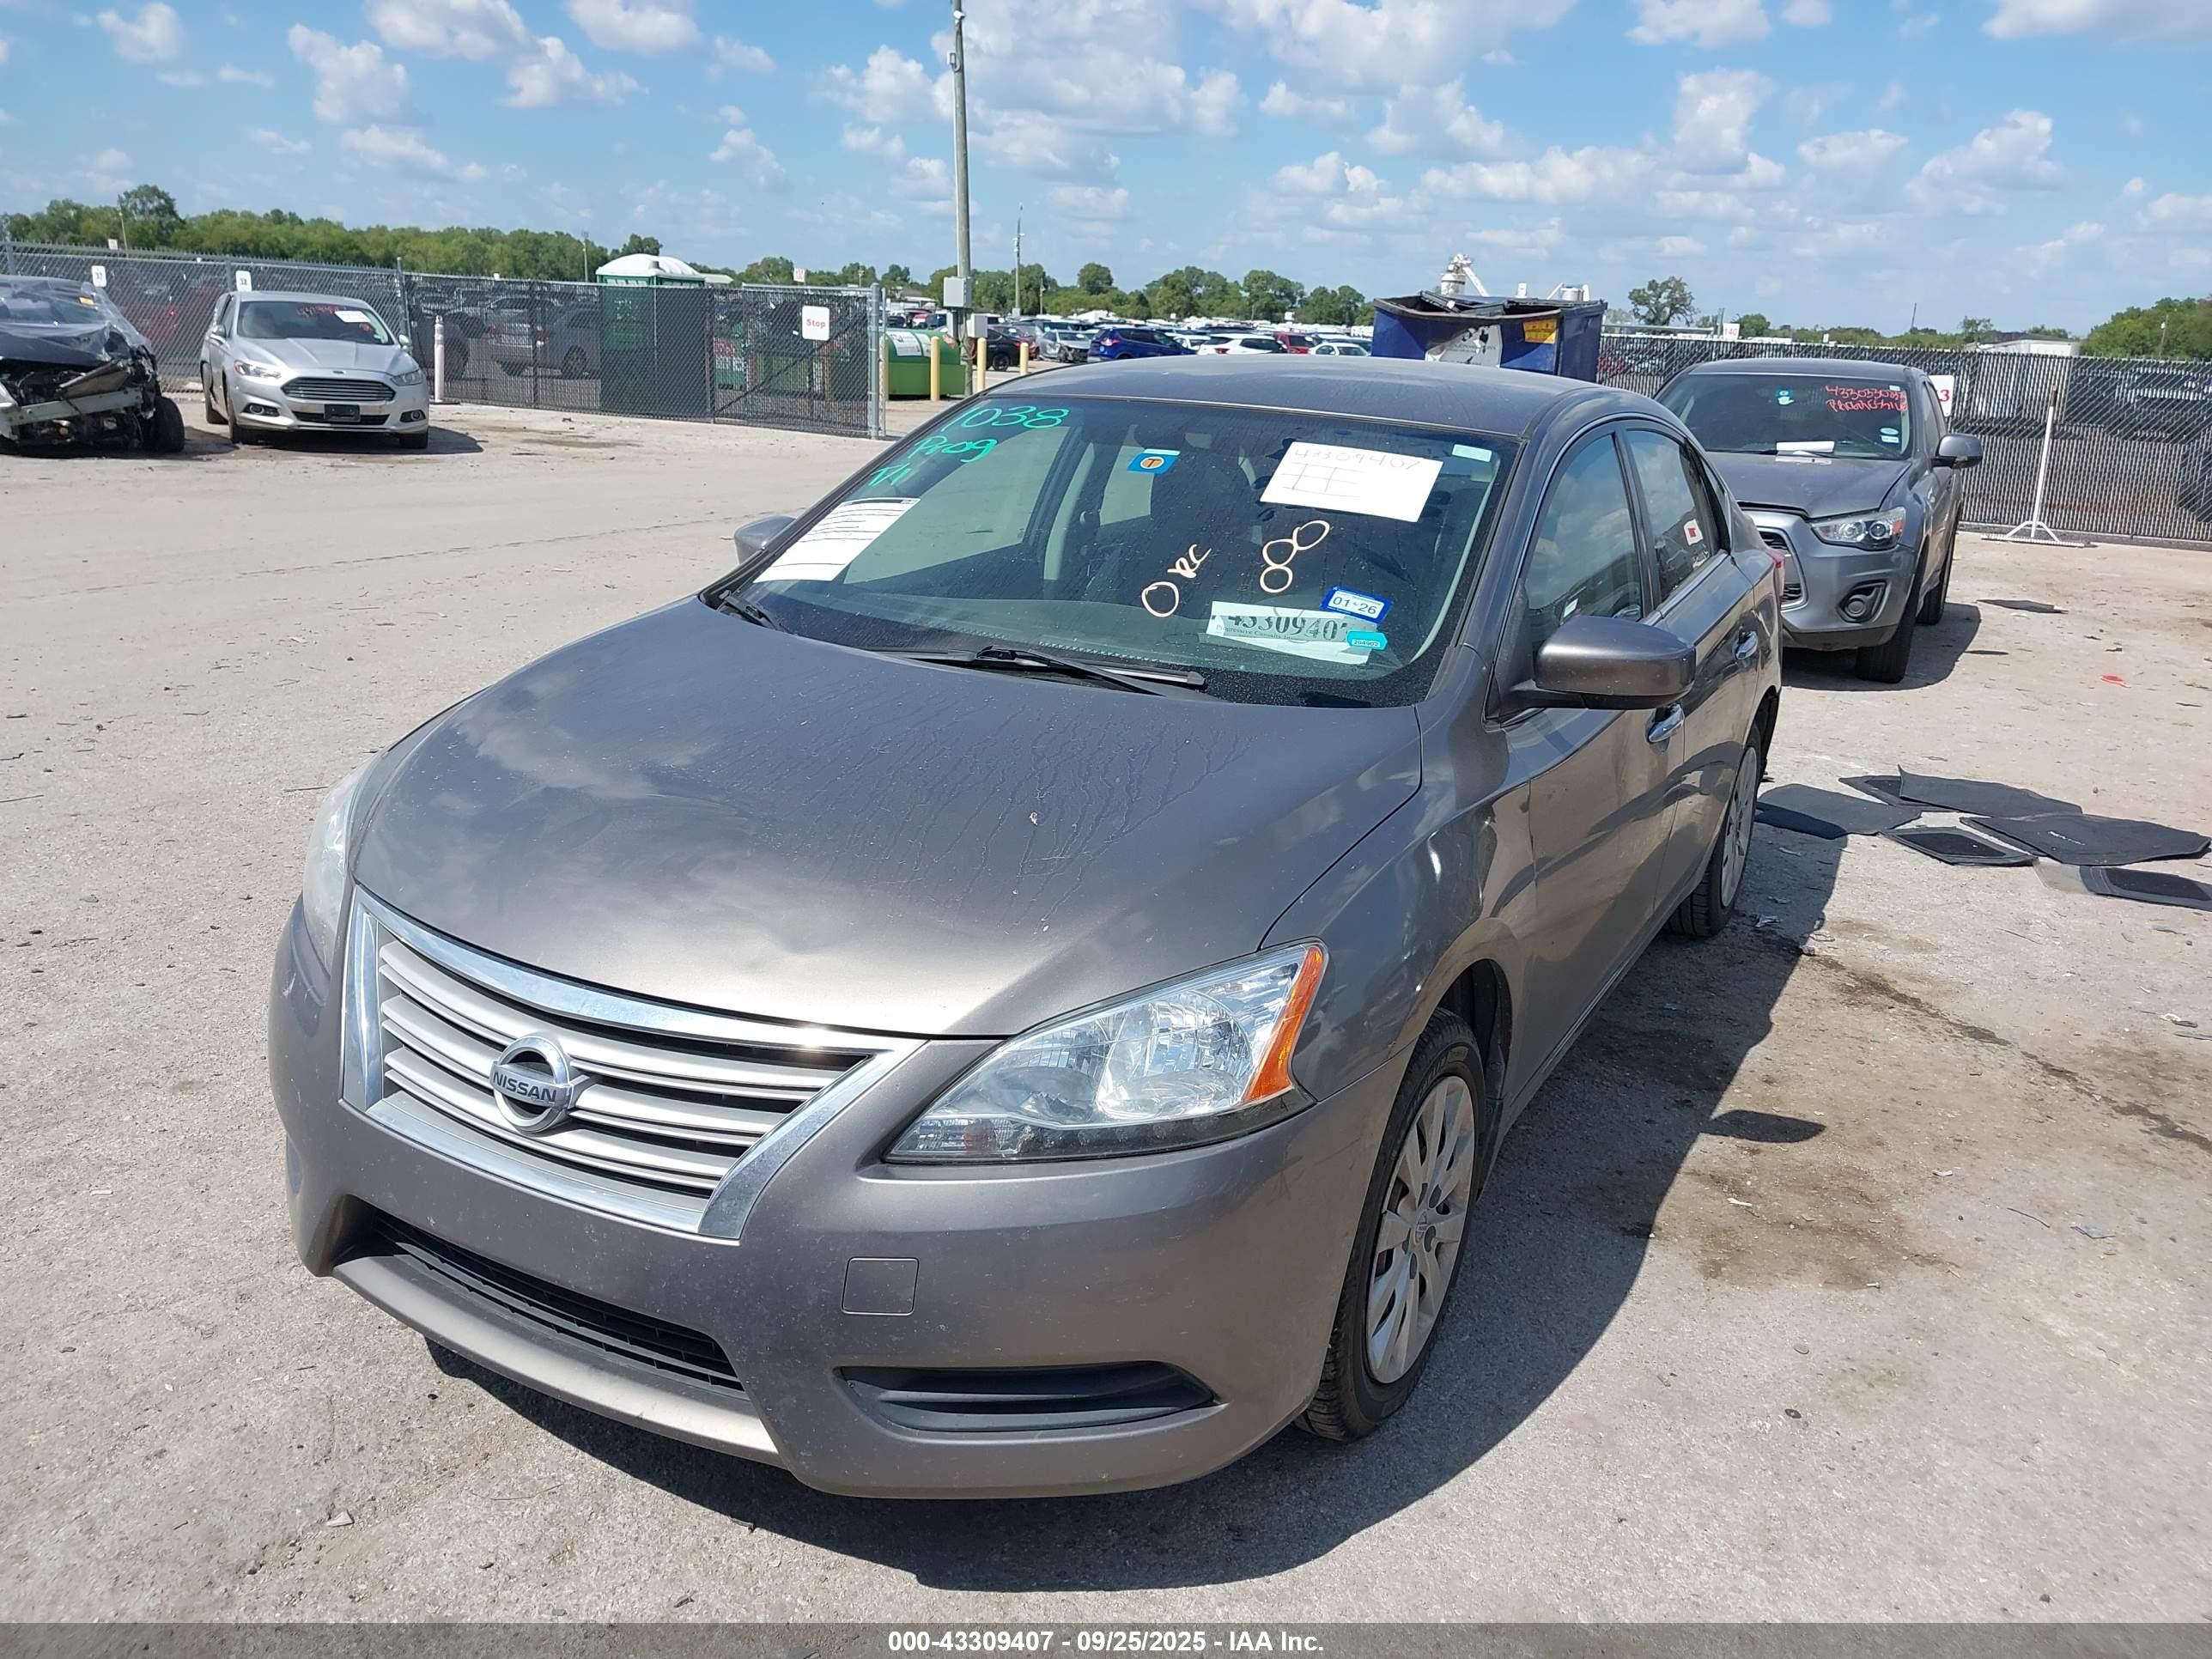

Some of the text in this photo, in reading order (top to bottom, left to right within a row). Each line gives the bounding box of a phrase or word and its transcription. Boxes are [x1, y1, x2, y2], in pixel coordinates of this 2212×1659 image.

[805, 319, 826, 328] Stop
[940, 405, 1069, 432] 1038
[1294, 449, 1421, 471] 43309407
[493, 1071, 557, 1103] NISSAN
